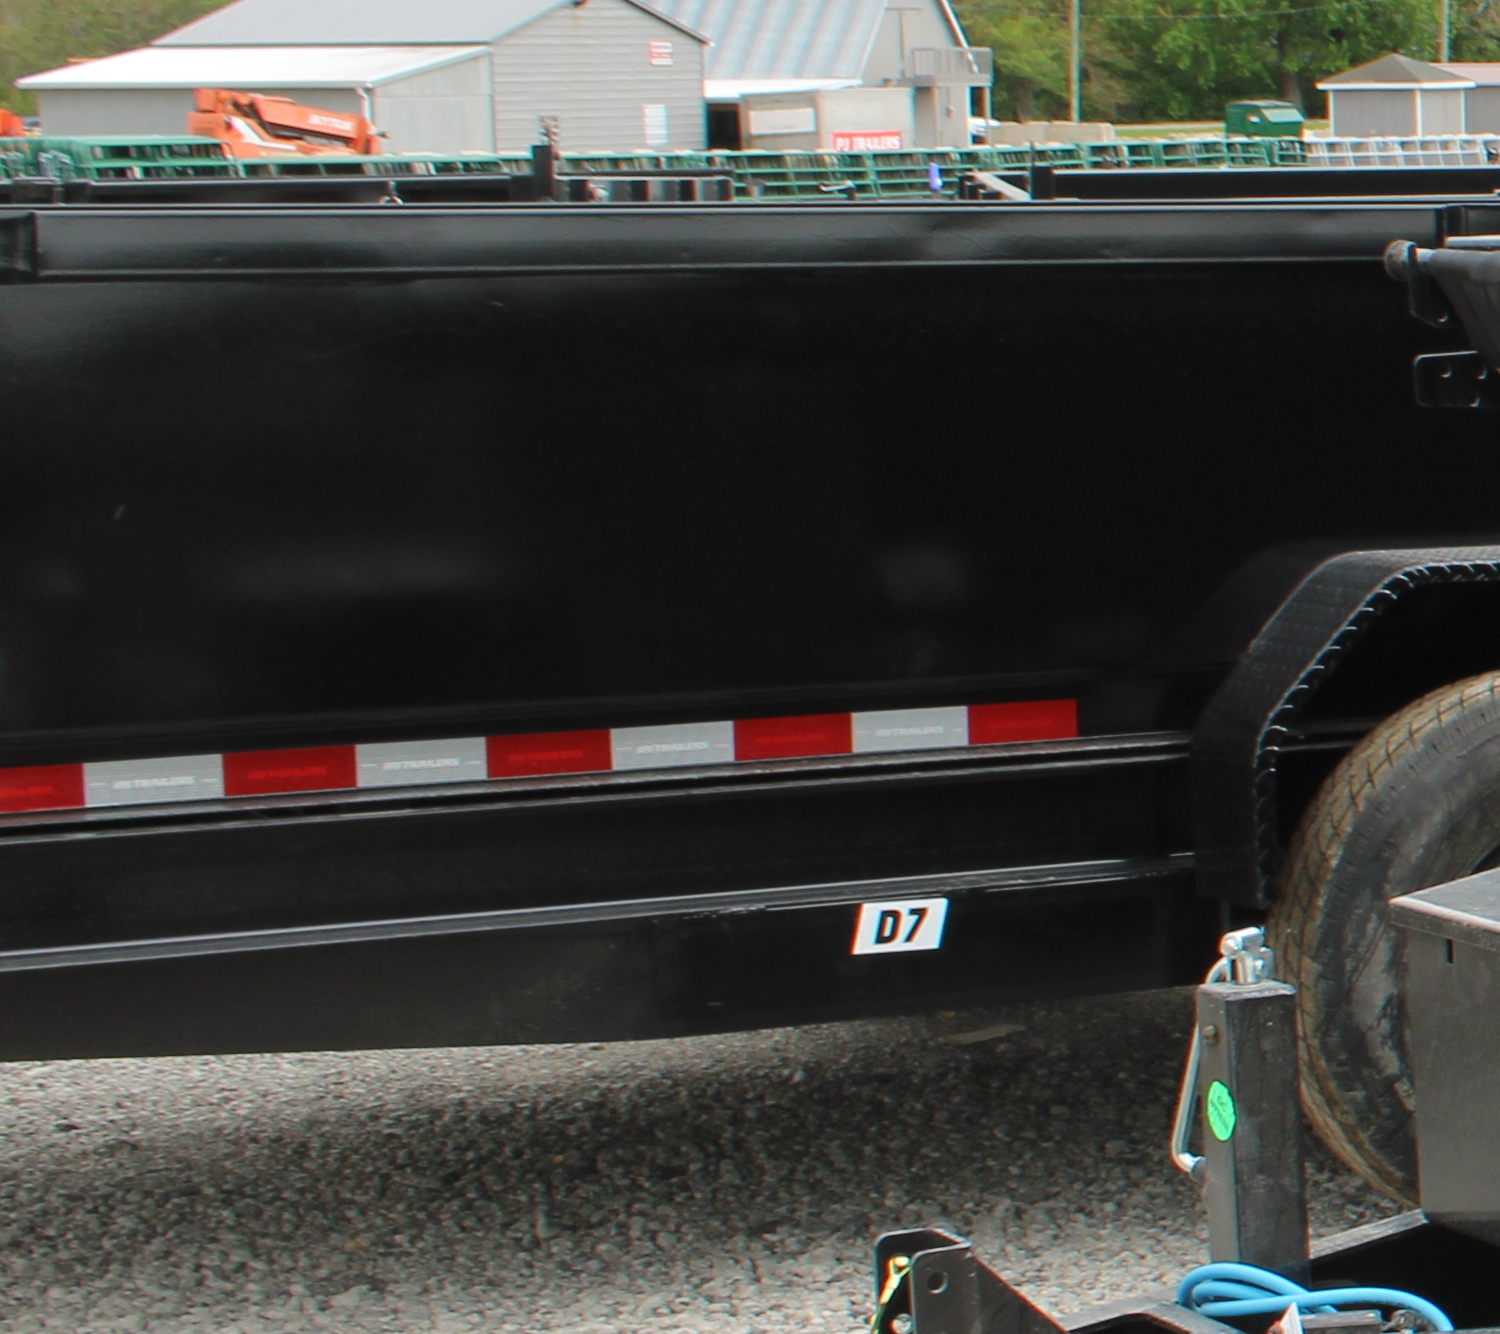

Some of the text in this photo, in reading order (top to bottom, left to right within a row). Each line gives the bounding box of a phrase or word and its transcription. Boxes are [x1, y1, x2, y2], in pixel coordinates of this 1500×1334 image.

[836, 135, 901, 151] PJ TRAILERS
[873, 907, 930, 945] D7
